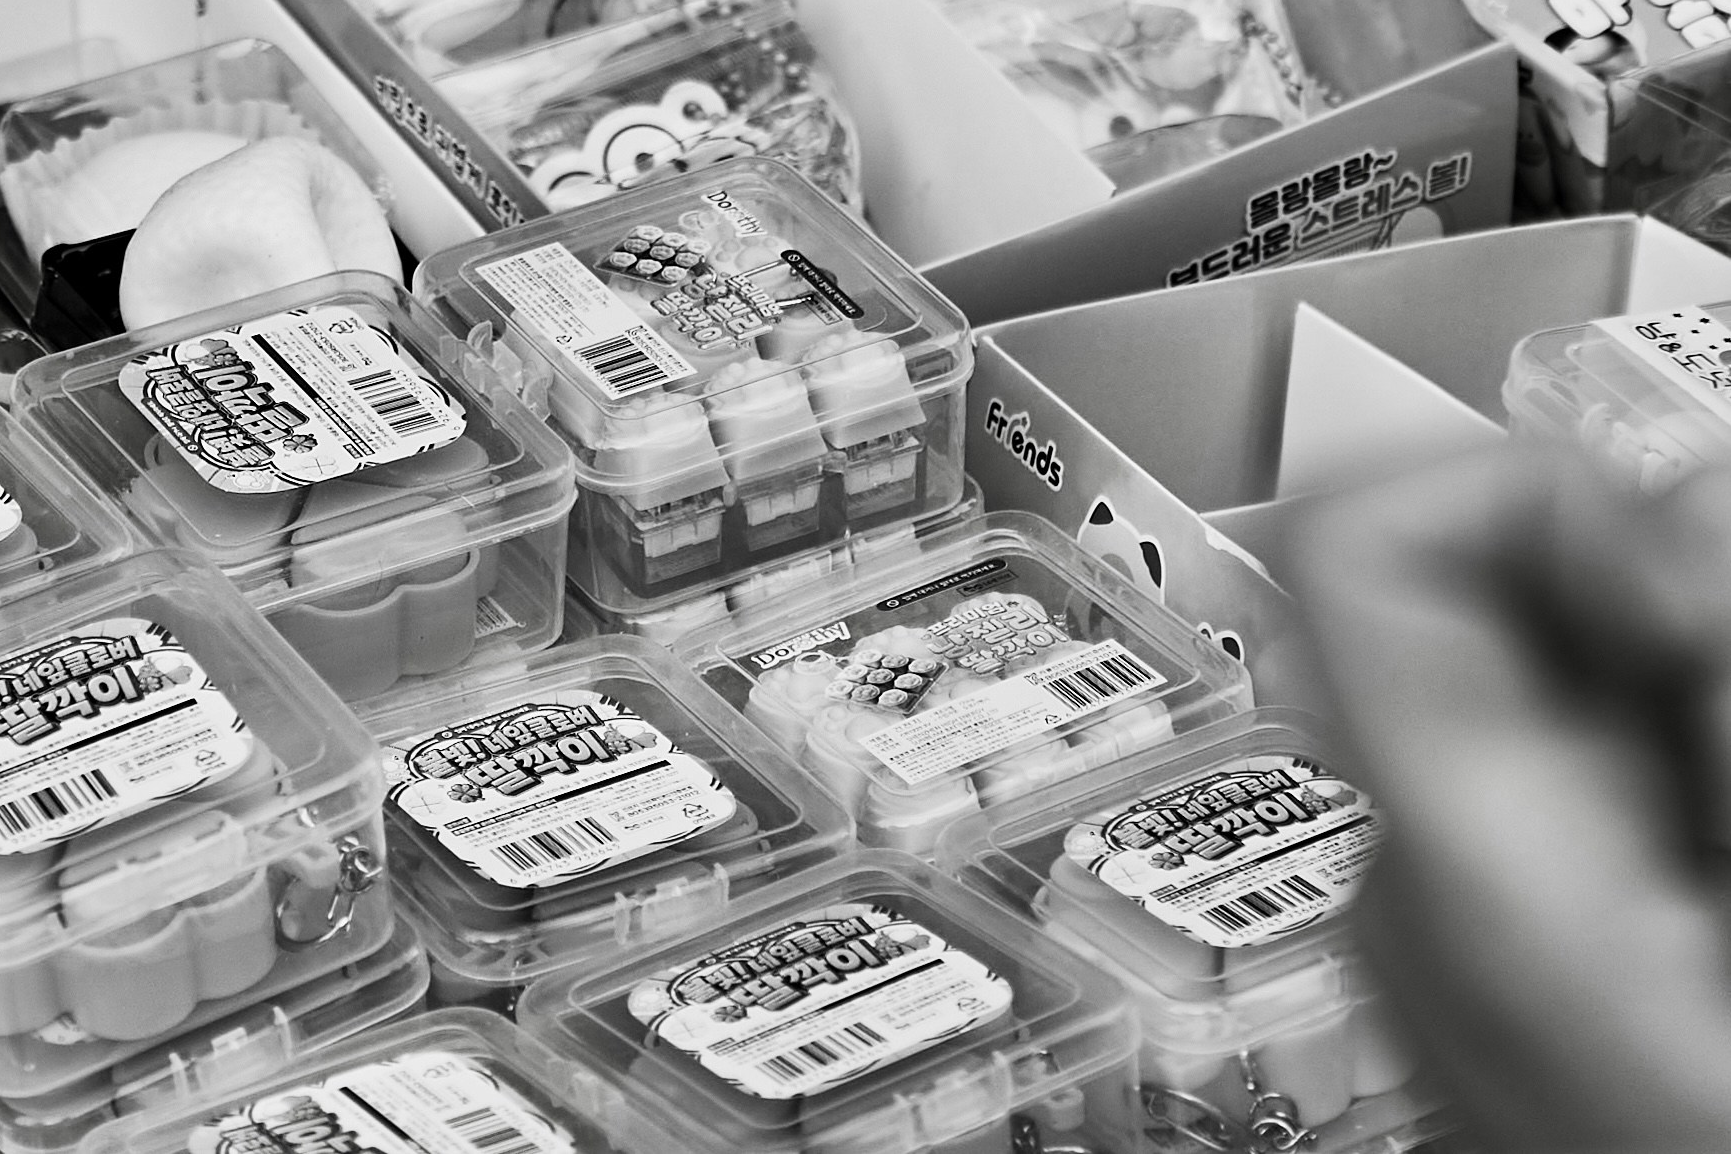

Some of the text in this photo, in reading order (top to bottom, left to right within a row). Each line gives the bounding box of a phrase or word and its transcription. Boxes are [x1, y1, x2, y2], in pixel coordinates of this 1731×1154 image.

[1299, 176, 1424, 248] 스트레스
[1428, 156, 1470, 202] 볼!
[927, 601, 1008, 636] 프리미엄
[957, 623, 1070, 675] 딸깍이
[466, 733, 607, 796] 딸깍이
[1159, 790, 1308, 861] 딸깍이
[727, 940, 879, 1009] 딸깍이
